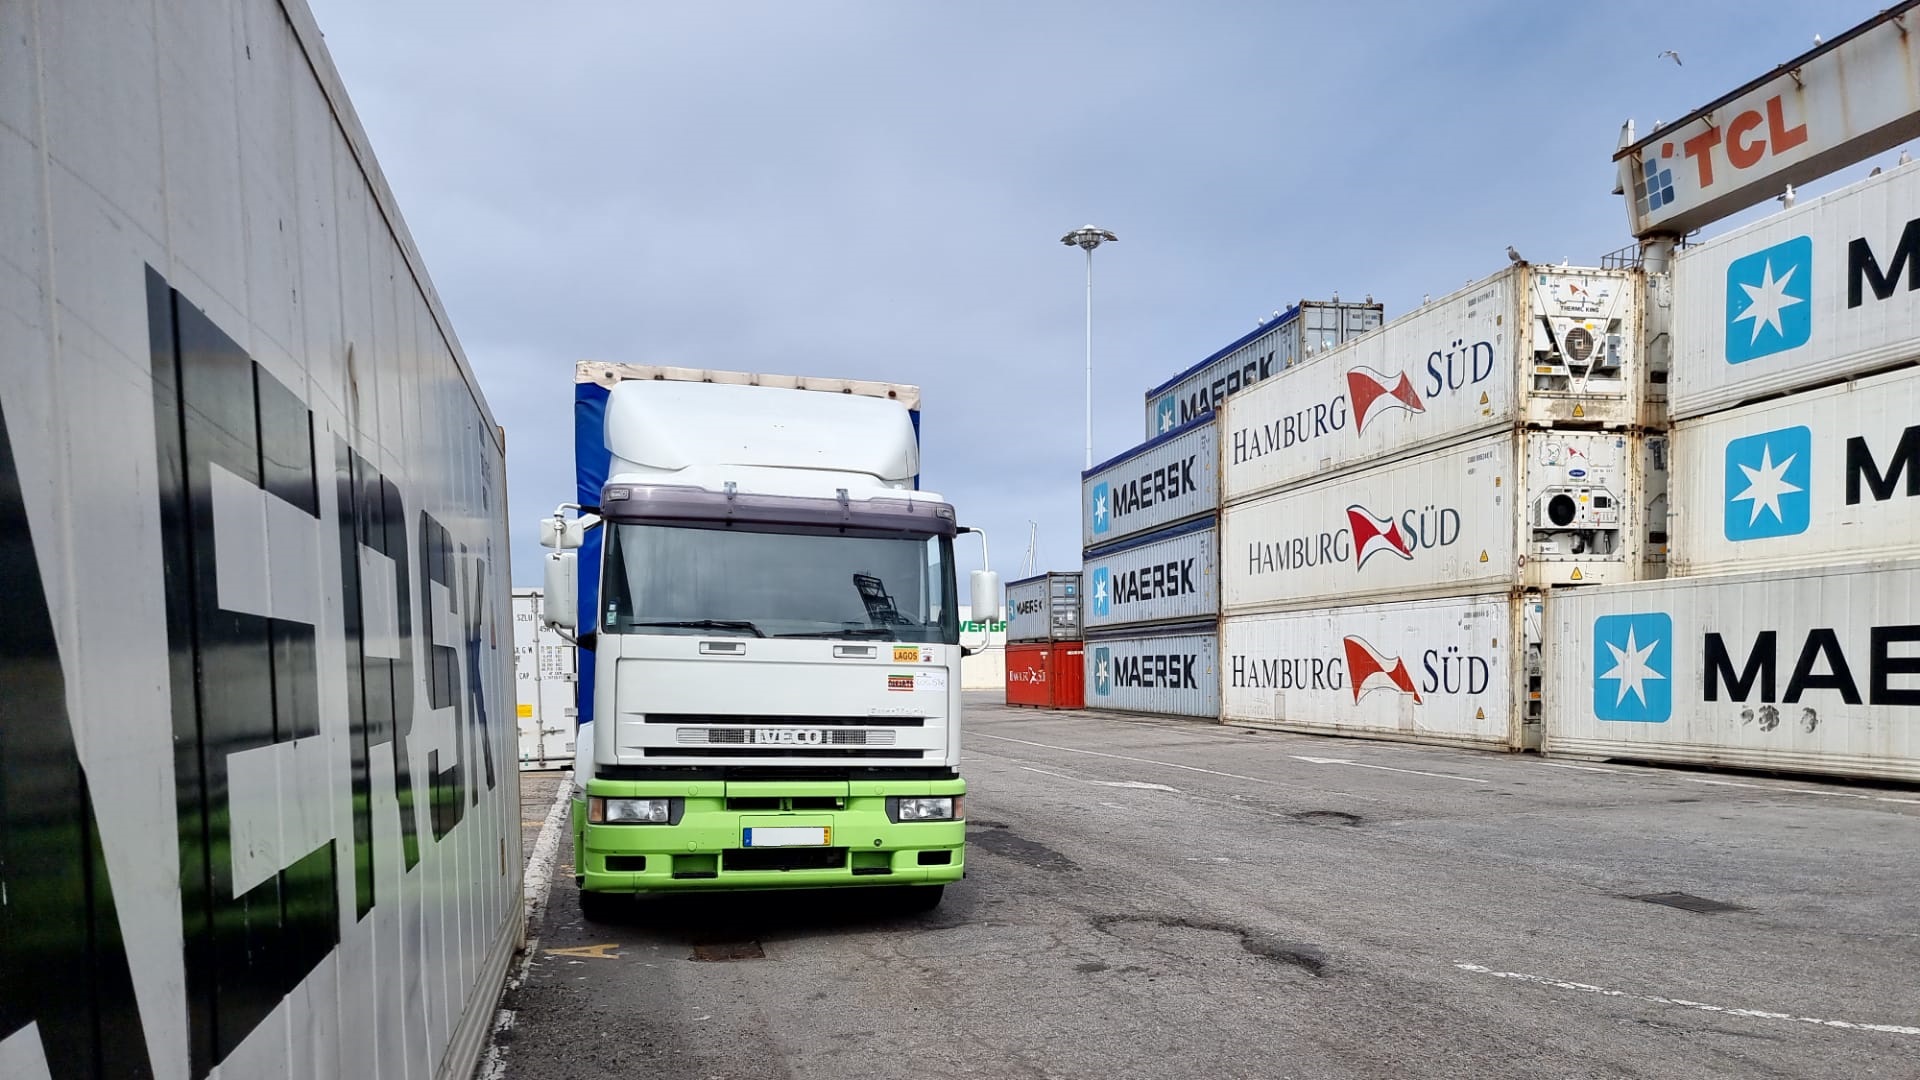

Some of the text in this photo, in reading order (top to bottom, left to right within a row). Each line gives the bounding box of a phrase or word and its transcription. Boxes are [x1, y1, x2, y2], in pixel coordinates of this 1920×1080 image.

[1684, 95, 1808, 188] TCL
[1233, 338, 1494, 466] HAMBURG SÜD
[1112, 455, 1196, 520] MAERSK
[1249, 504, 1461, 576] HAMBURG SÜD
[1112, 557, 1196, 604] MAERSK
[1016, 599, 1043, 616] MAERSK
[894, 651, 918, 661] LAGOS
[1113, 653, 1198, 690] MAERSK
[1231, 646, 1489, 695] HAMBURG SÜD
[1703, 625, 1920, 706] MAE
[754, 729, 823, 745] IVECO
